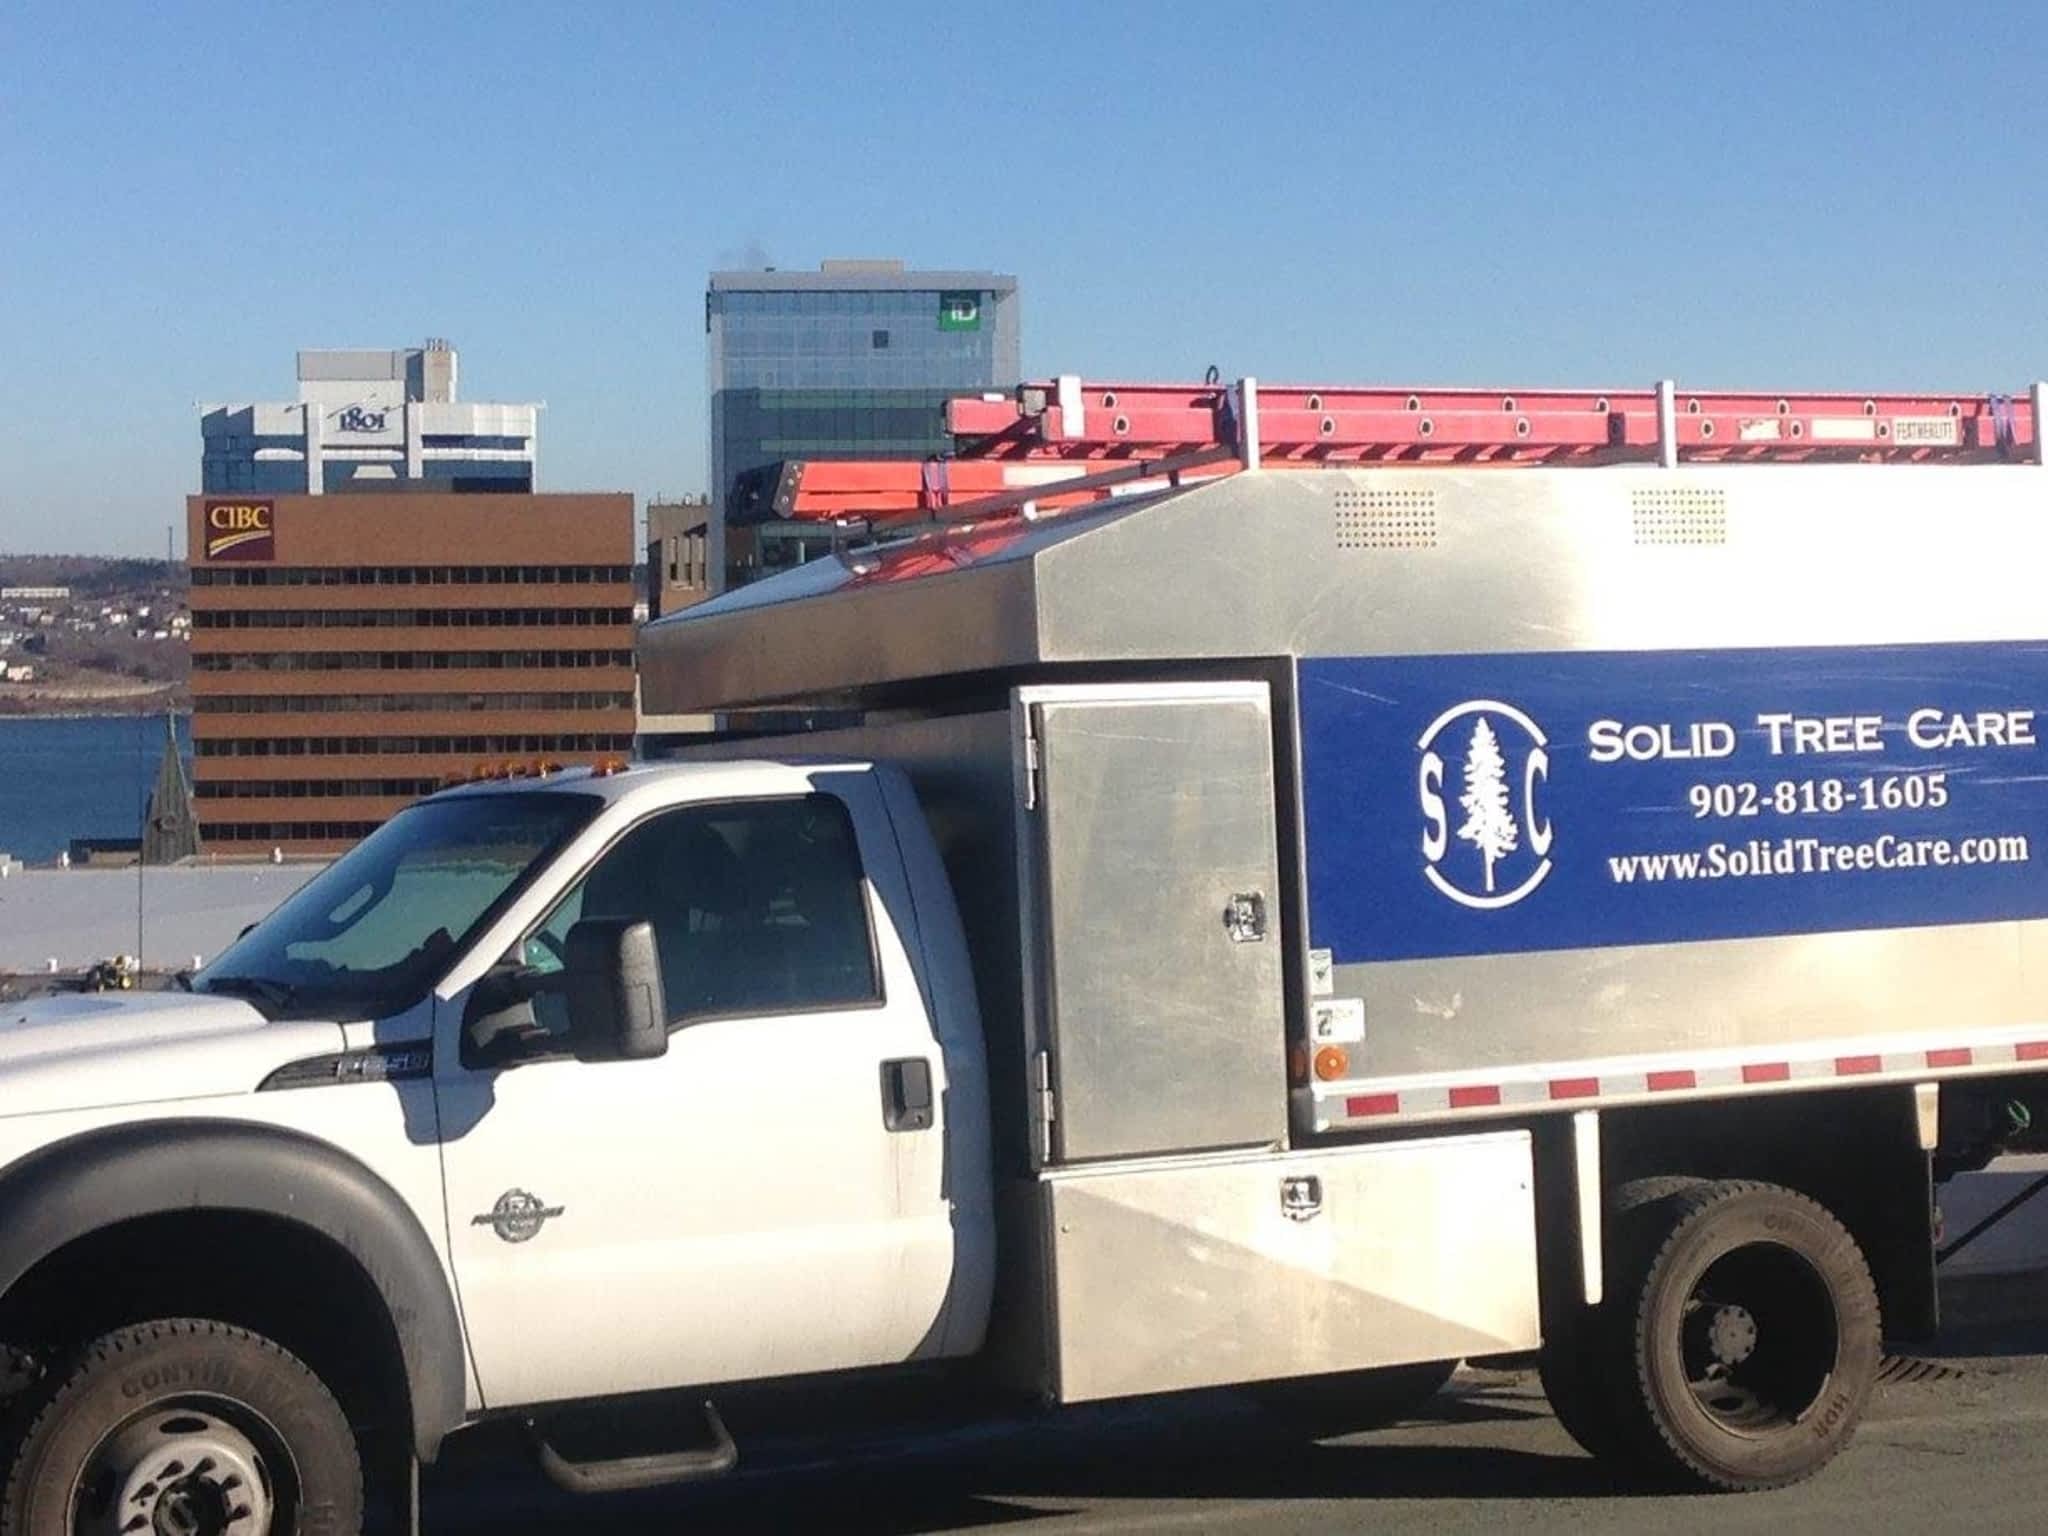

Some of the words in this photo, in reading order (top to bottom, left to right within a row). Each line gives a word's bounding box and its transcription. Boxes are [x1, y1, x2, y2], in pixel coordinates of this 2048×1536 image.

[210, 506, 269, 529] CIBC
[1690, 774, 1949, 818] 902-818-1605
[1609, 834, 2029, 884] www.SolidTreeCare.com
